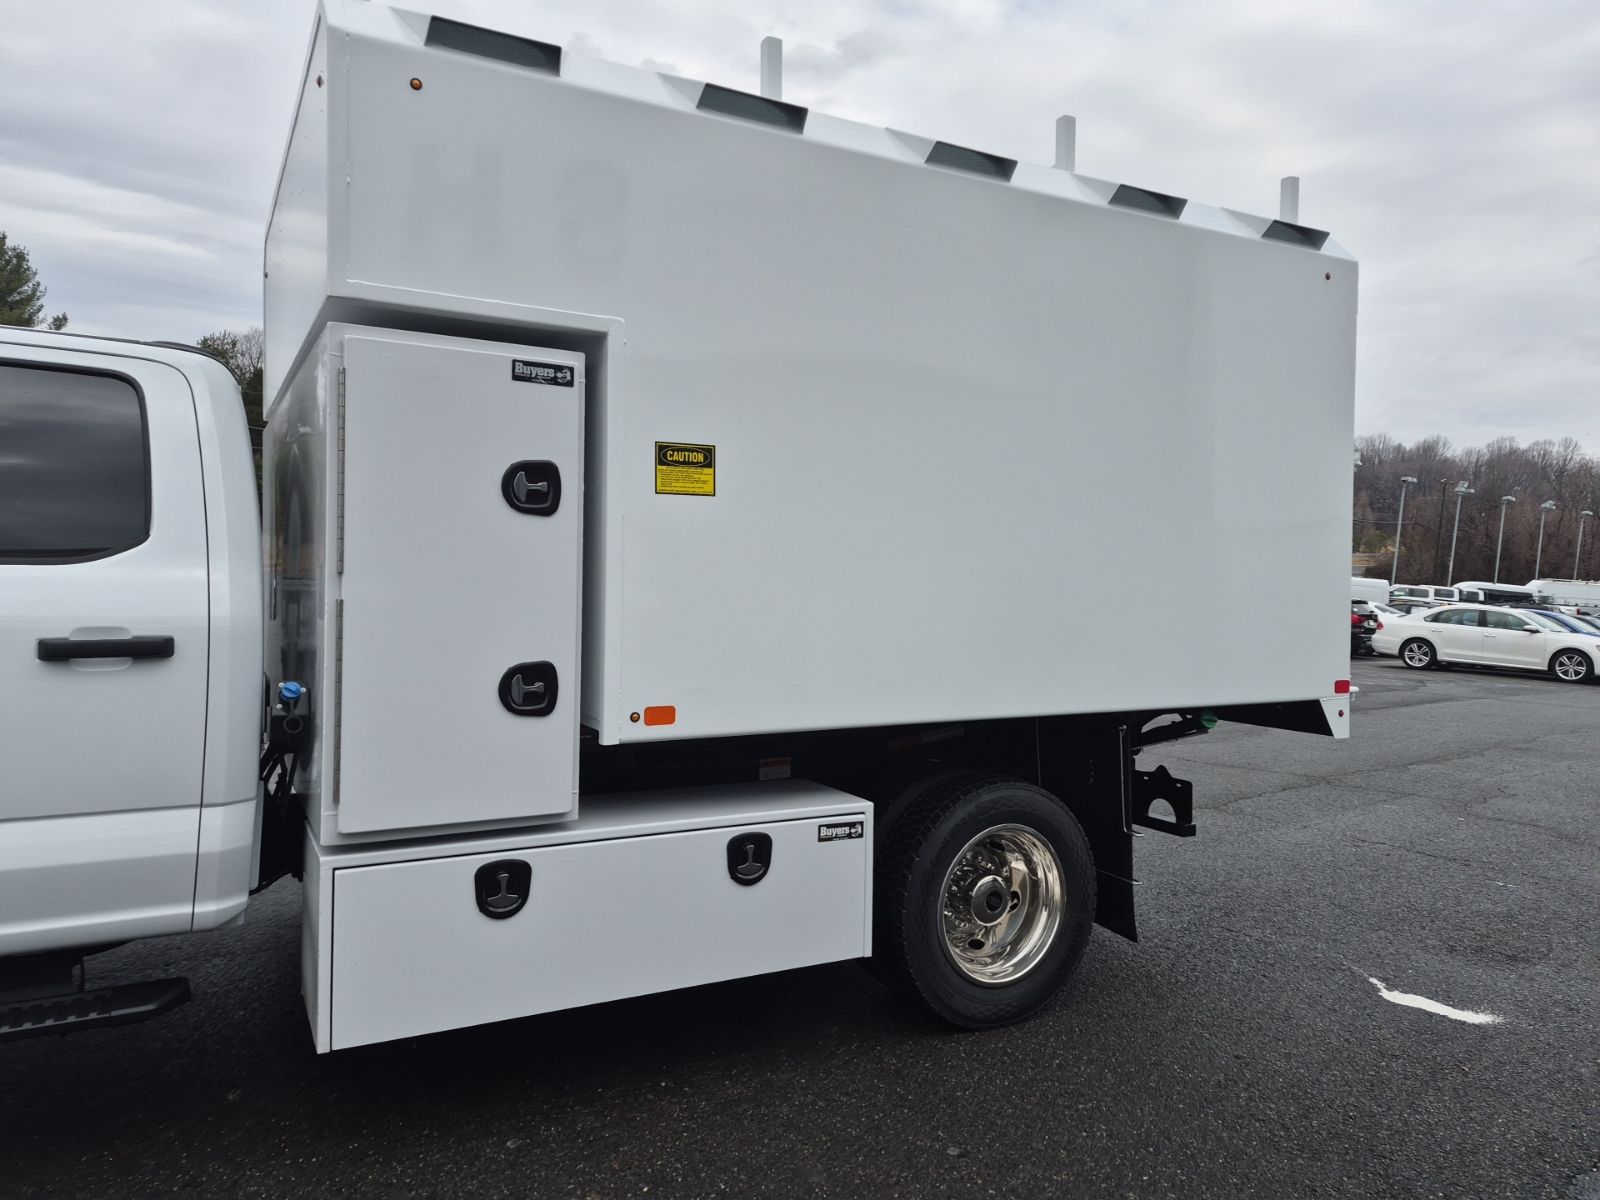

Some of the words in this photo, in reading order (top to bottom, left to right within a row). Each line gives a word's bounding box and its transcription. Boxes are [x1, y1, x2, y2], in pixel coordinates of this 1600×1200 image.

[514, 361, 555, 378] Buyers
[667, 450, 704, 463] CAUTION
[820, 826, 850, 838] Buyers
